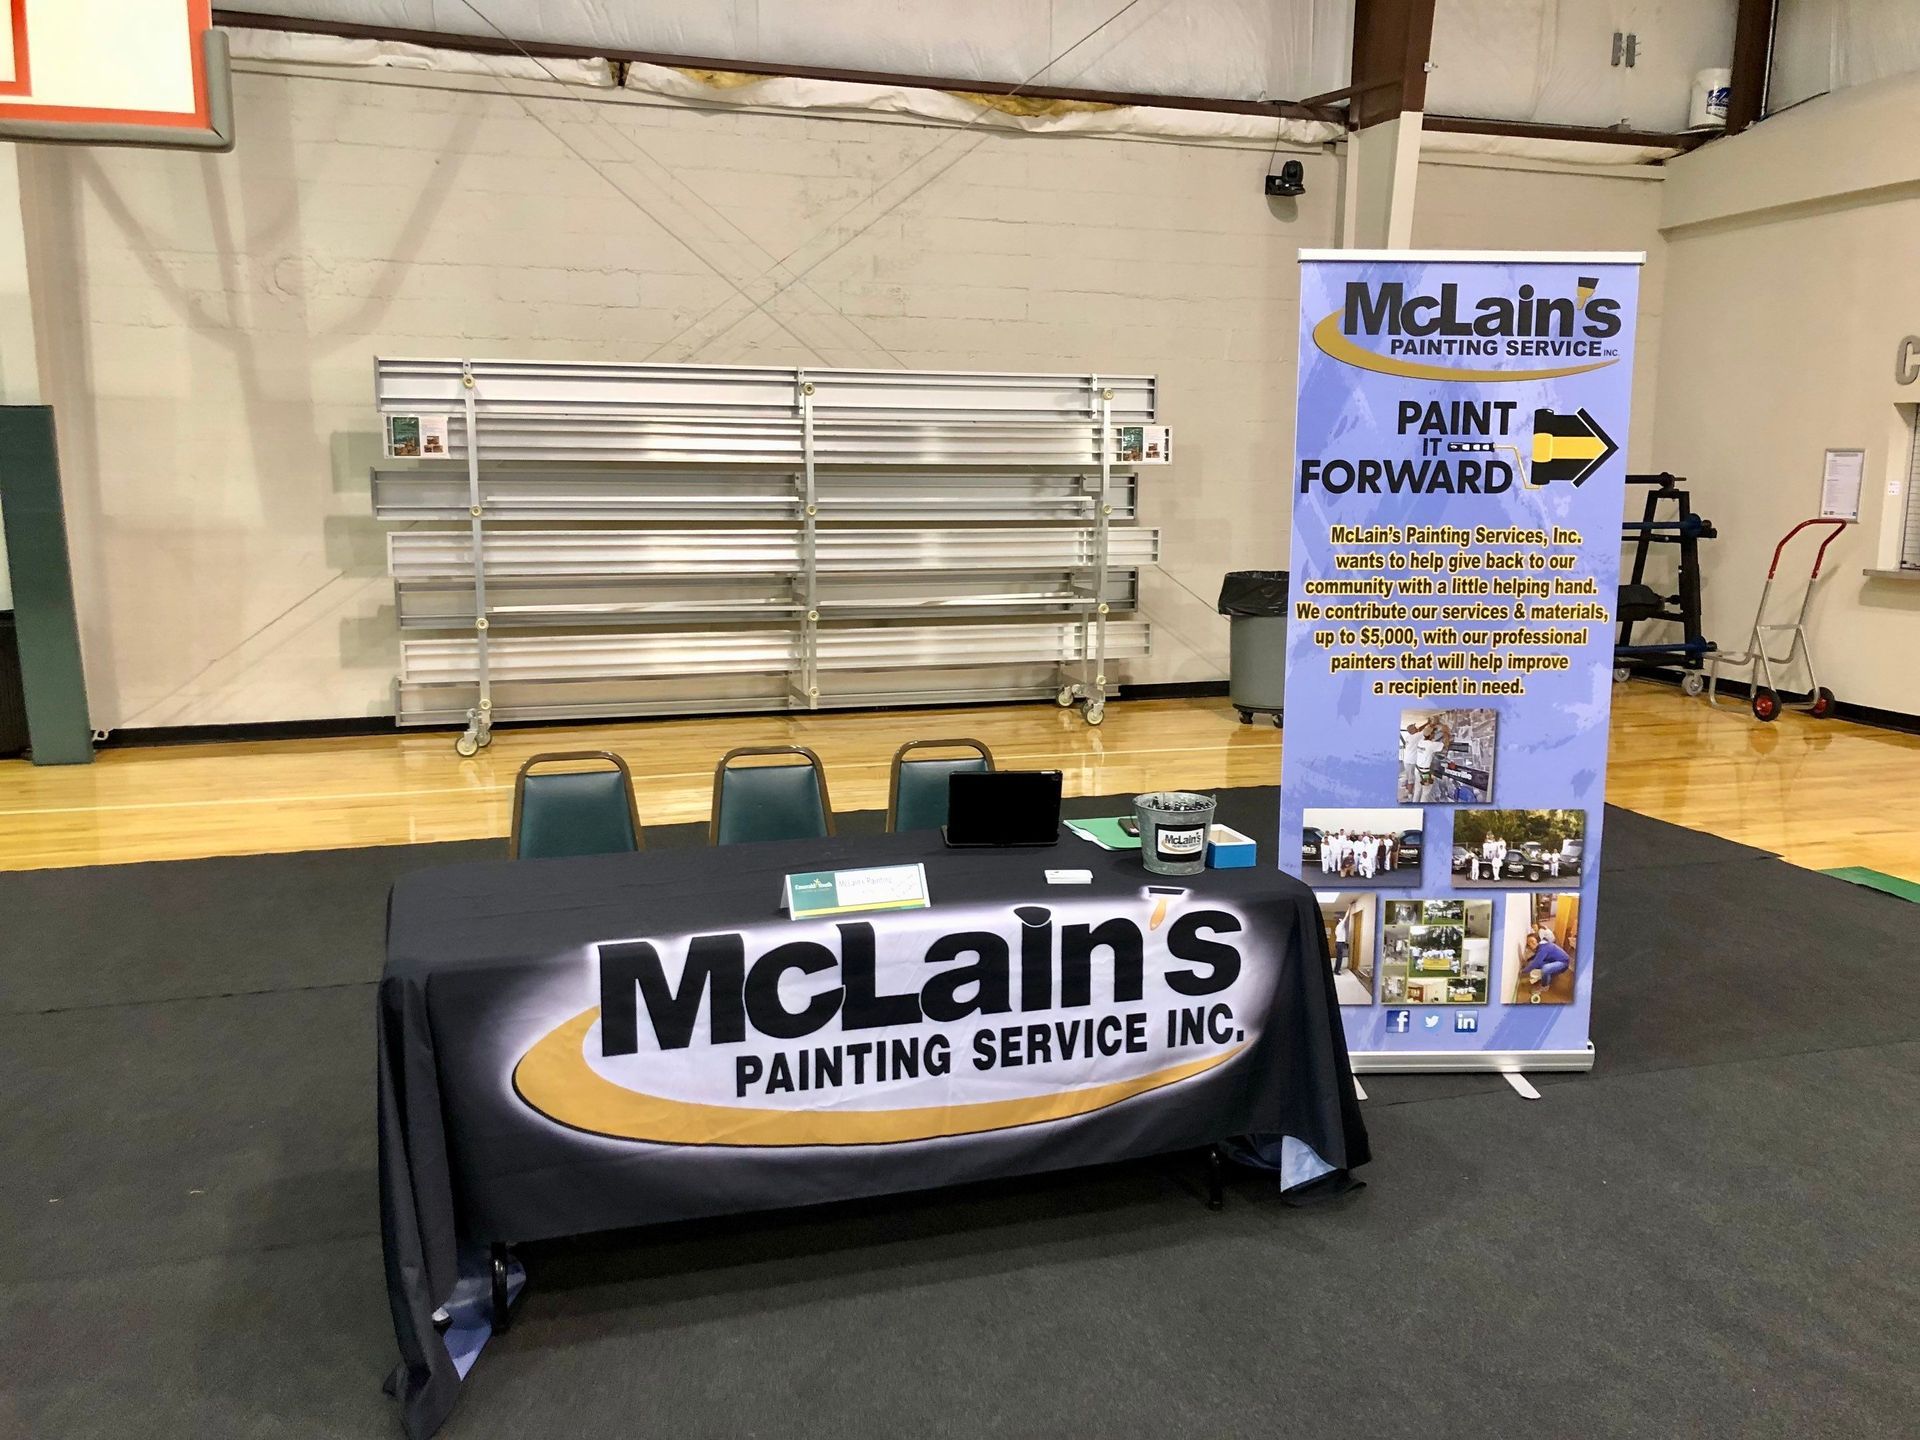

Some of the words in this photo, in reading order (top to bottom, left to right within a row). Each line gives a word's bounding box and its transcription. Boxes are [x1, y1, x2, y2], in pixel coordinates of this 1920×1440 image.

[1344, 277, 1622, 338] McLain's
[1390, 339, 1498, 356] PAINTING
[1506, 340, 1602, 357] SERVICE
[1397, 400, 1518, 436] PAINT
[1422, 437, 1442, 457] IT
[1300, 459, 1513, 494] FORWARD
[1331, 526, 1401, 543] McLain's
[1406, 526, 1470, 547] Painting
[1475, 526, 1547, 546] Services,
[1553, 527, 1582, 544] Inc.
[1336, 553, 1384, 569] wants
[1389, 554, 1404, 569] to
[1410, 552, 1443, 572] help
[1449, 553, 1480, 572] give
[1486, 552, 1523, 569] back
[1529, 554, 1544, 569] to
[1550, 556, 1575, 569] our
[1305, 578, 1393, 597] community
[1398, 578, 1432, 594] with
[1437, 581, 1447, 594] a
[1452, 578, 1488, 594] little
[1493, 578, 1549, 597] helping
[1555, 578, 1597, 594] hand.
[1296, 603, 1320, 619] We
[1325, 602, 1406, 619] contribute
[1412, 607, 1437, 619] our
[1442, 604, 1508, 619] services
[1514, 604, 1525, 619] &
[1531, 604, 1608, 622] materials,
[1316, 632, 1334, 647] up
[1340, 630, 1355, 644] to
[1361, 627, 1417, 646] $5,000,
[1424, 628, 1457, 644] with
[1462, 632, 1488, 644] our
[1493, 629, 1587, 647] professional
[1331, 654, 1395, 672] painters
[1401, 654, 1432, 669] that
[1438, 653, 1464, 669] will
[1469, 654, 1502, 672] help
[1508, 654, 1568, 672] improve
[1374, 682, 1383, 694] a
[1389, 679, 1458, 697] recipient
[1463, 679, 1477, 694] in
[1482, 678, 1524, 694] need.
[597, 887, 1242, 1058] McLain's
[736, 1033, 951, 1098] PAINTING
[972, 1012, 1148, 1070] SERVICE
[1167, 1003, 1244, 1048] INC.
